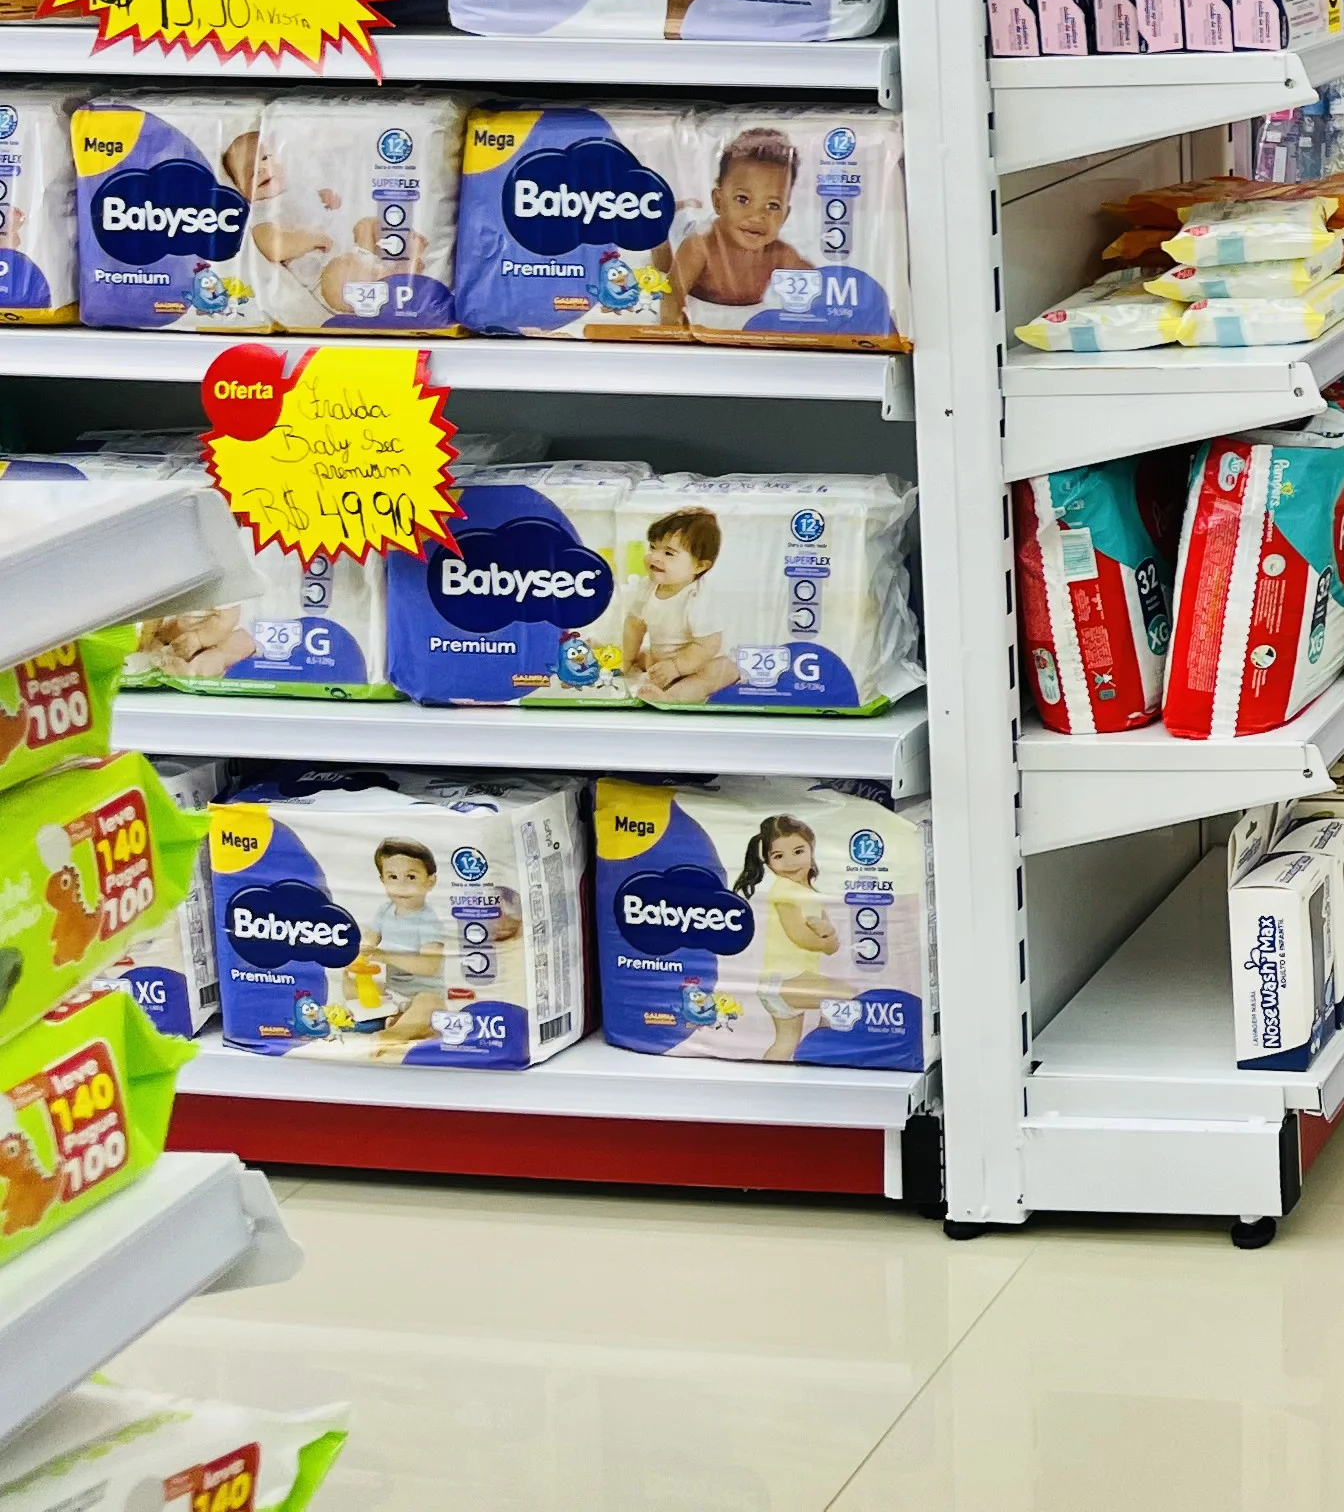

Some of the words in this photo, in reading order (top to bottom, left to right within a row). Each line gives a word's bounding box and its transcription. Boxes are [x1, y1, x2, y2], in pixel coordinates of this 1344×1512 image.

[84, 137, 124, 157] Mega
[474, 131, 515, 150] Mega
[514, 179, 663, 225] Babysec
[102, 197, 243, 238] Babysec
[95, 268, 170, 286] Premium
[502, 259, 584, 278] Premium
[357, 287, 376, 303] 34
[785, 277, 810, 295] 32
[826, 278, 857, 307] M
[396, 286, 413, 309] P
[214, 380, 273, 400] Oferta
[272, 424, 350, 463] Baby
[784, 554, 831, 566] SUPERFLEX
[442, 558, 601, 602] Babysec
[1136, 564, 1160, 595] 32
[267, 627, 290, 645] 26
[305, 626, 331, 656] G
[430, 636, 517, 655] Premium
[1147, 621, 1171, 648] XG
[750, 652, 776, 671] 26
[793, 652, 821, 683] G
[28, 671, 80, 700] Pague
[28, 691, 88, 739] 100
[98, 805, 136, 836] leve
[615, 815, 655, 836] Mega
[98, 819, 147, 873] 140
[221, 830, 259, 852] Mega
[858, 840, 876, 857] 12
[844, 880, 894, 892] SUPERFLEX
[103, 876, 154, 931] 100
[449, 894, 501, 907] SUPERFLEX
[623, 894, 745, 932] Babysec
[233, 908, 350, 948] Babysec
[1257, 915, 1276, 955] Max
[617, 956, 682, 973] Premium
[231, 968, 296, 986] Premium
[135, 980, 166, 1002] XG
[831, 1003, 853, 1019] 24
[864, 1001, 905, 1027] XXG
[443, 1017, 464, 1033] 24
[477, 1017, 507, 1039] XG
[51, 1059, 98, 1095] leve
[51, 1074, 115, 1133] 140
[63, 1131, 126, 1191] 100
